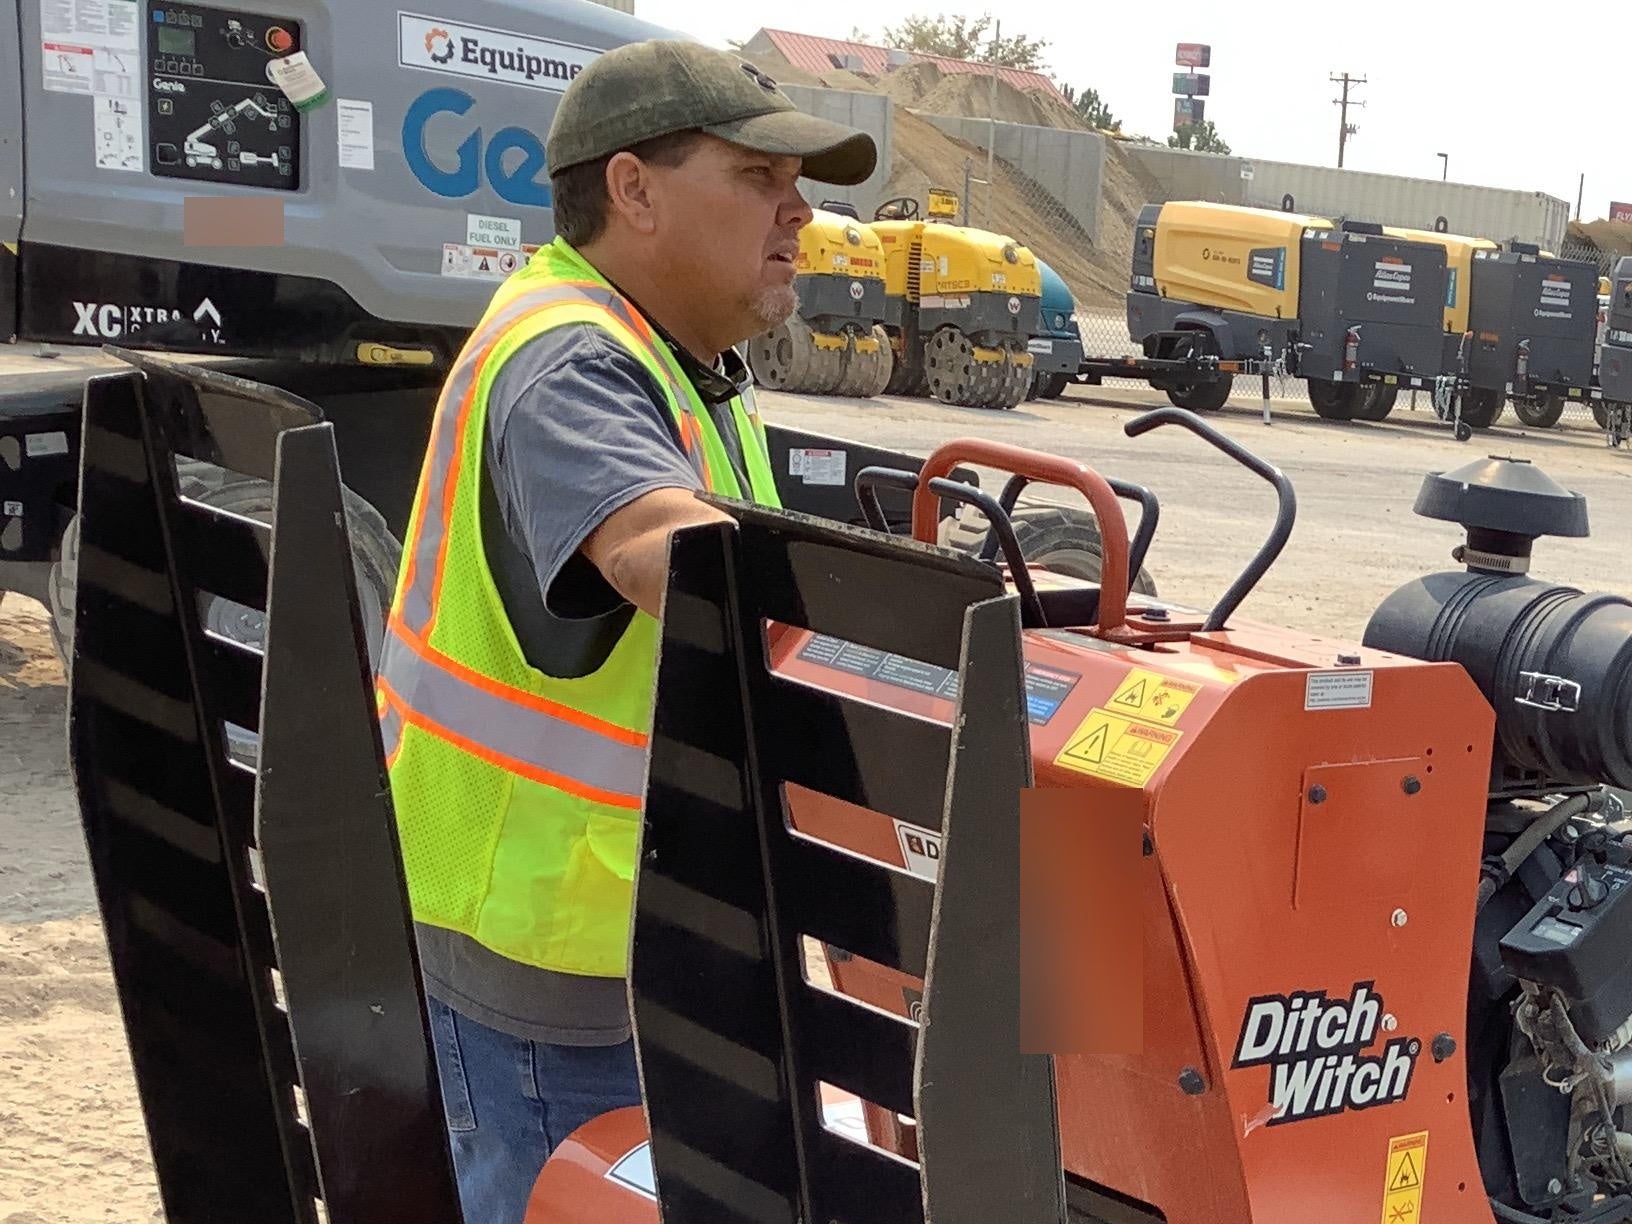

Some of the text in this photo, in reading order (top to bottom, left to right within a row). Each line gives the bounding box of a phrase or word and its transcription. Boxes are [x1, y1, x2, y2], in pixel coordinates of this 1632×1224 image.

[460, 35, 583, 81] Equipme
[152, 77, 186, 93] Genie
[401, 86, 553, 208] Ge
[469, 230, 517, 246] FUEL ONLY
[478, 219, 509, 232] DIESEL
[72, 301, 122, 338] XC
[1238, 988, 1379, 1062] Ditch
[1271, 1044, 1412, 1119] Witch
